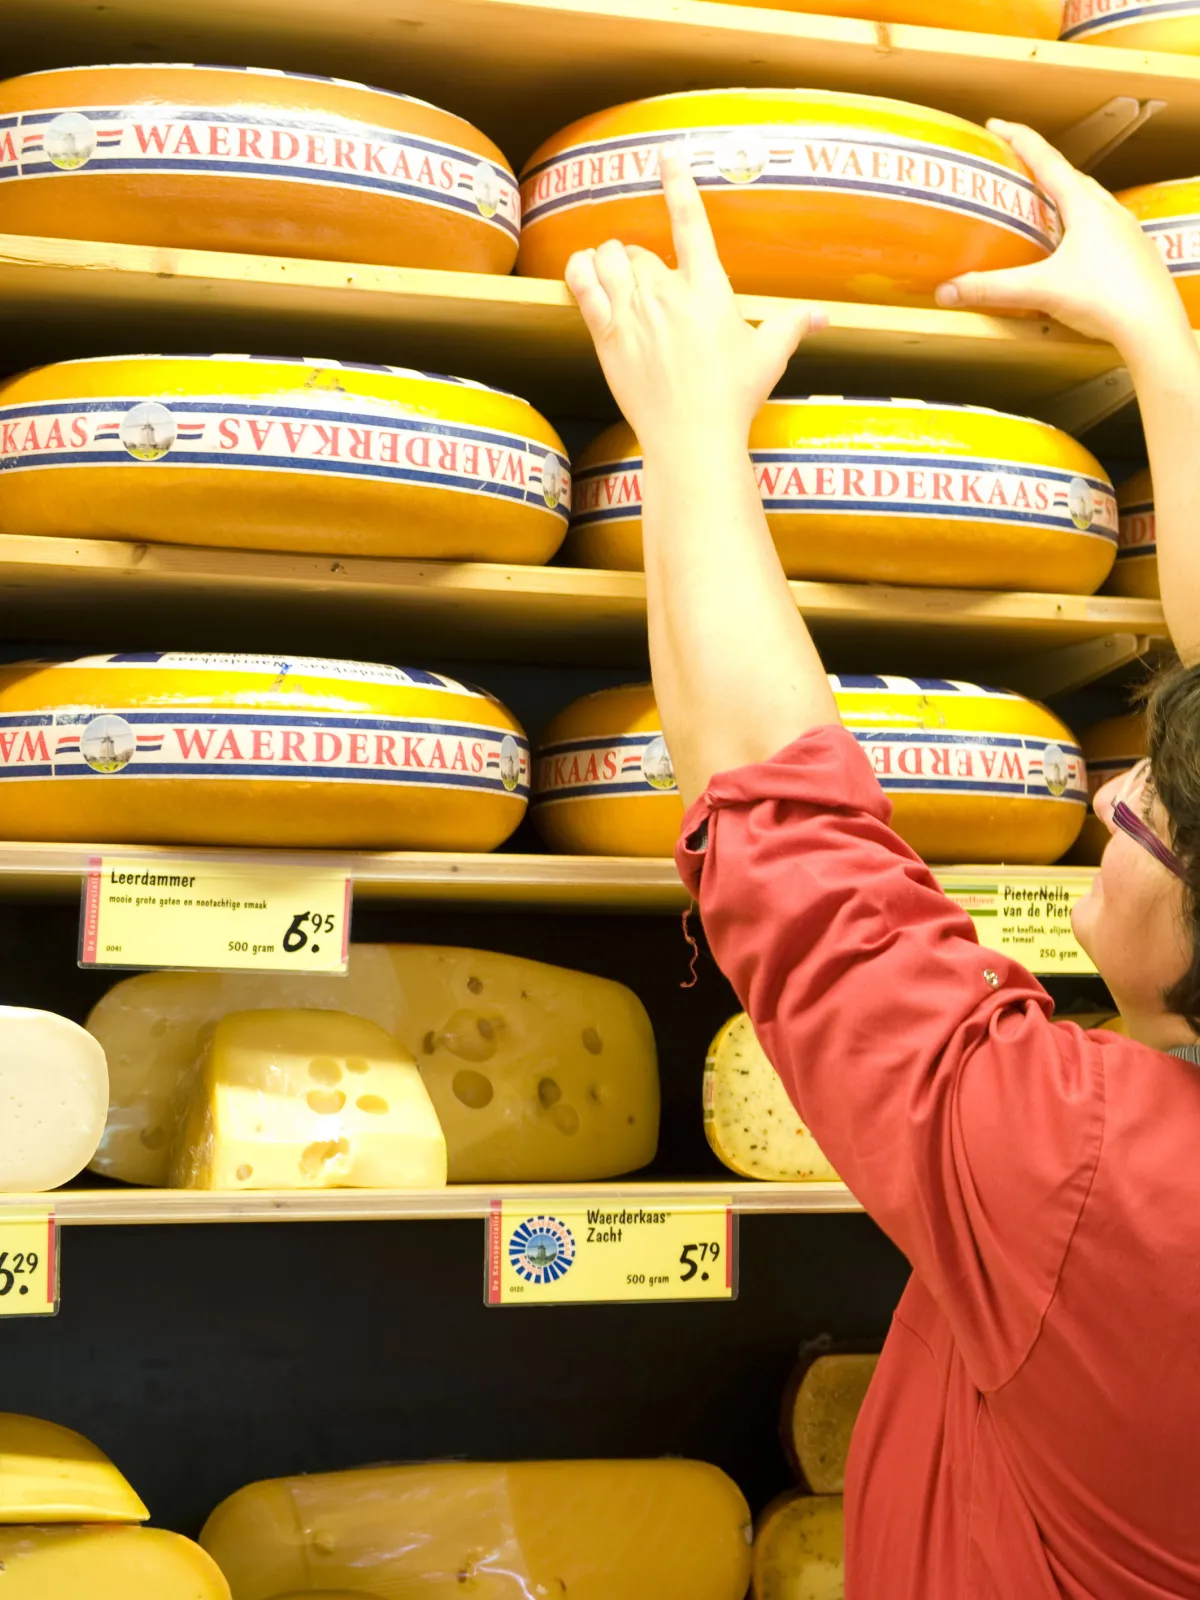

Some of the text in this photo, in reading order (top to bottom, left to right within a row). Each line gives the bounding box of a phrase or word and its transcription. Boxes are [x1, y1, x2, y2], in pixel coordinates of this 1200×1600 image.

[132, 123, 455, 190] WAERDERKAAS
[219, 418, 526, 486] WAERDERKAAS
[754, 467, 1049, 510] WAERDERKAAS
[173, 728, 484, 773] WAERDERKAAS
[110, 870, 196, 887] Leerdammer
[1004, 885, 1069, 900] PieterNella
[109, 895, 268, 910] mooie grote gaten en nootachtige smaak
[1003, 907, 1022, 917] van
[1027, 903, 1040, 917] de
[282, 911, 335, 953] 6.95
[228, 941, 275, 955] 500 gram
[1040, 949, 1078, 961] 250 gram
[587, 1228, 622, 1242] Zacht
[679, 1242, 720, 1282] 5.79
[626, 1274, 669, 1286] 500 gram
